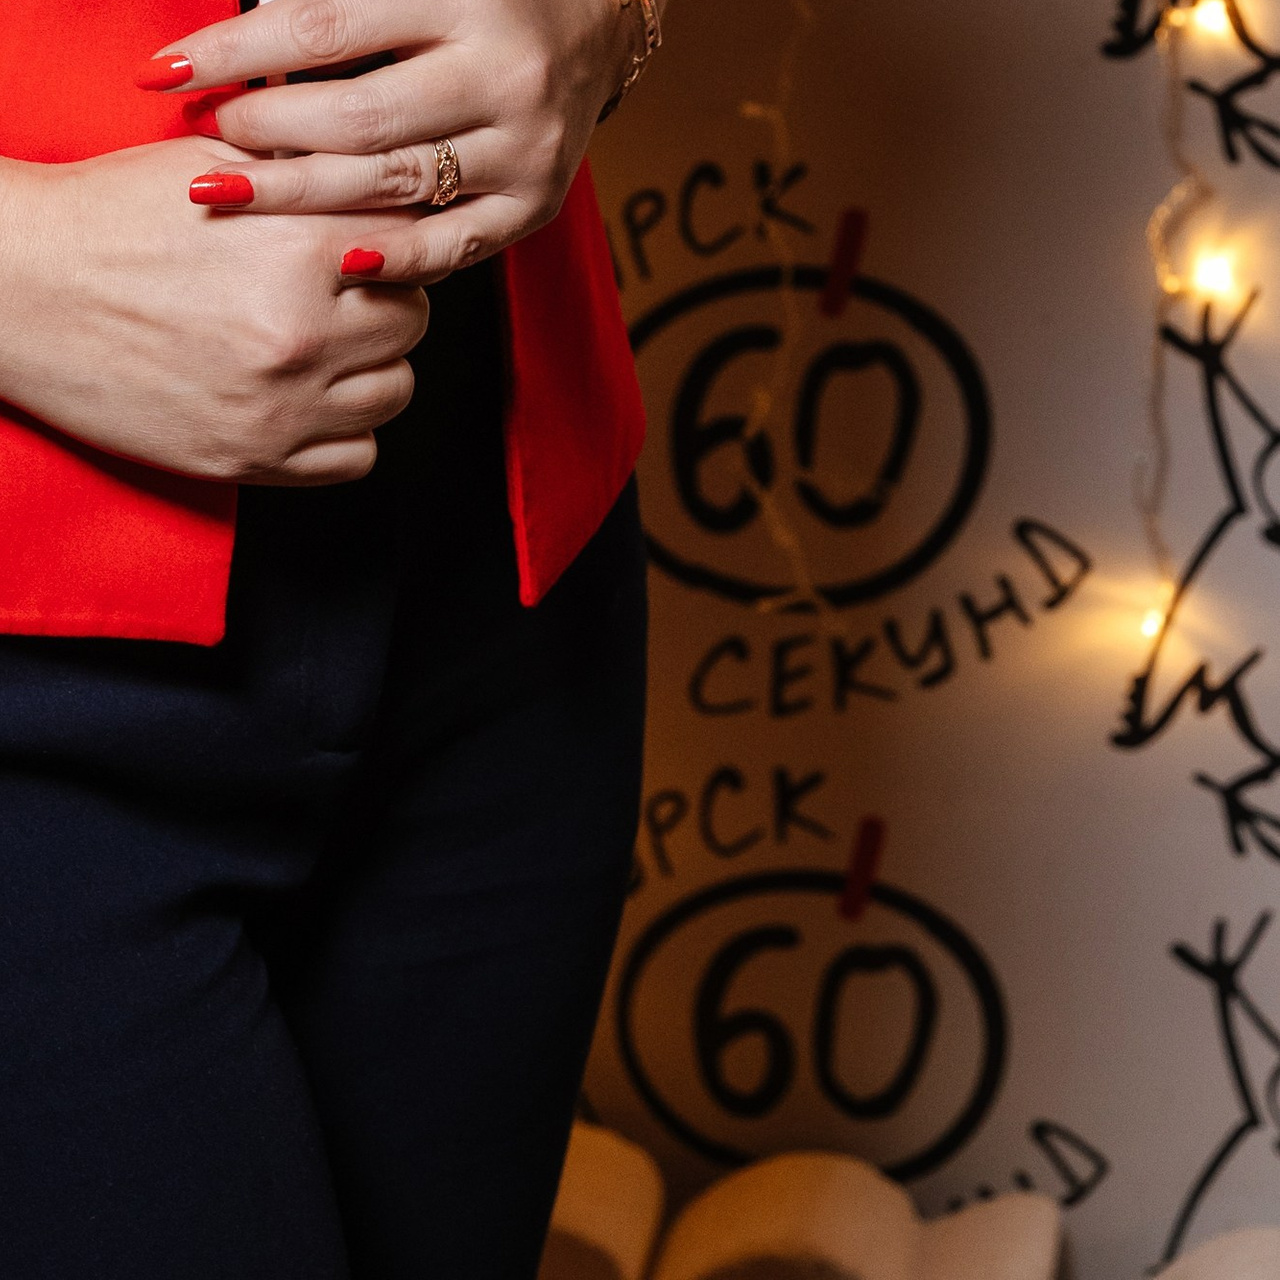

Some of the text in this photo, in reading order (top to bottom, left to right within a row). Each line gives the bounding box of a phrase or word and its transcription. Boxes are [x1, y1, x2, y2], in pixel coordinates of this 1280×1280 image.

[670, 325, 924, 535] 60
[687, 516, 1093, 719] СЕКУНД
[693, 923, 939, 1122] 60
